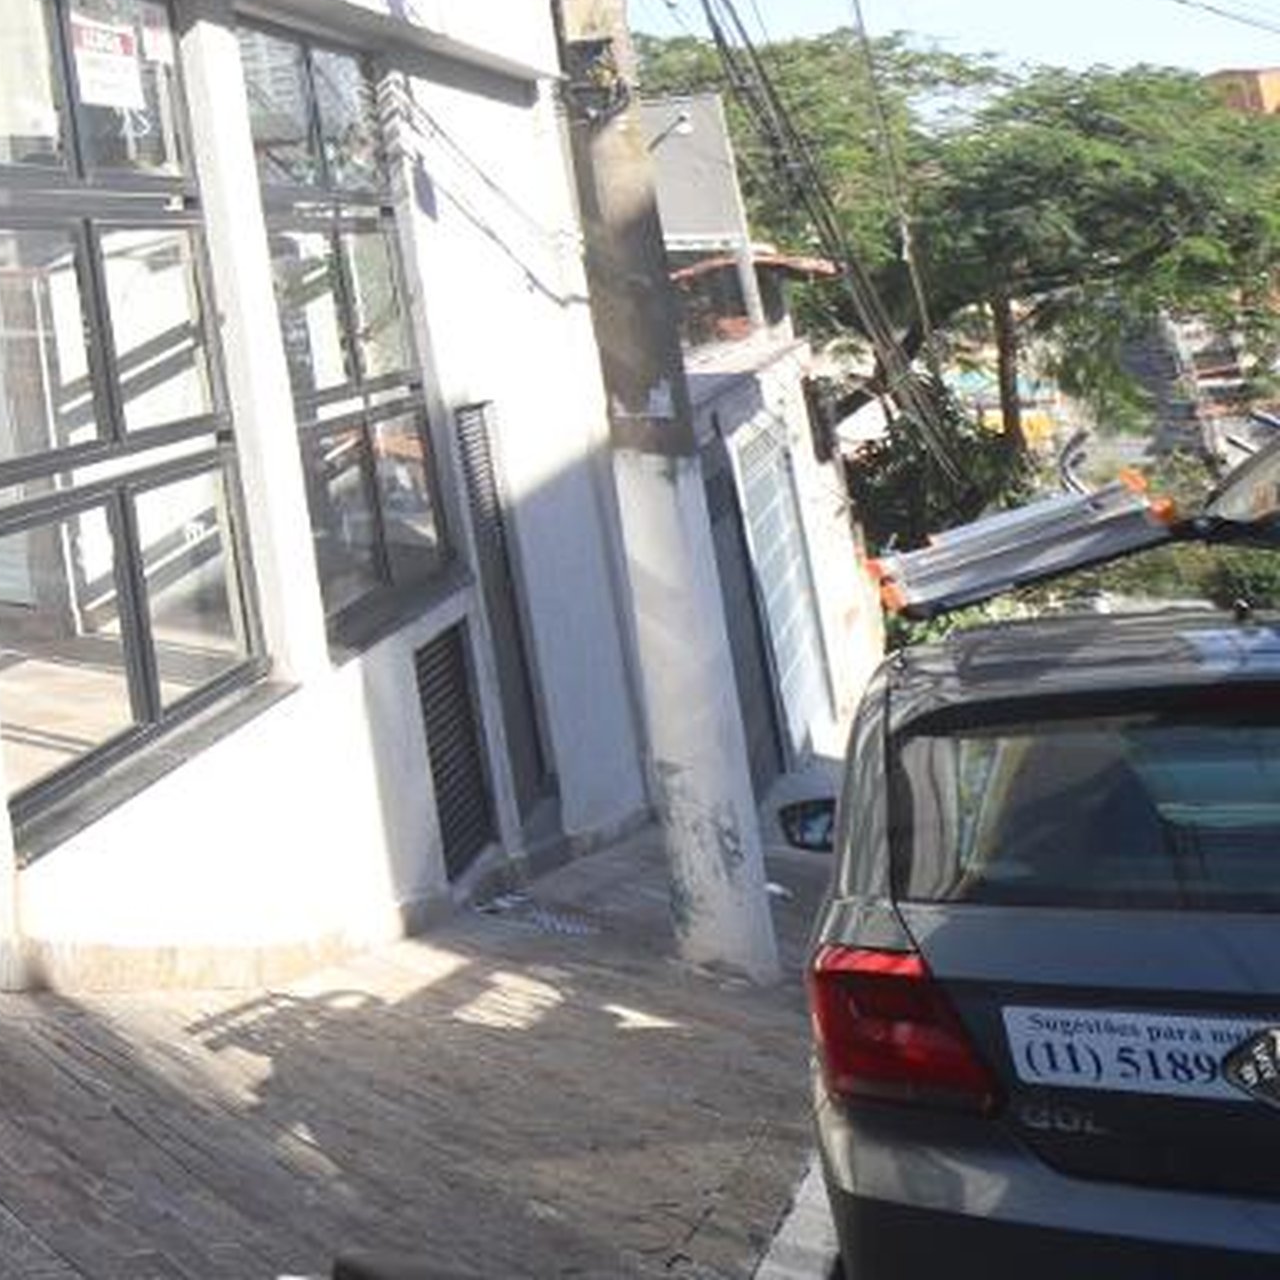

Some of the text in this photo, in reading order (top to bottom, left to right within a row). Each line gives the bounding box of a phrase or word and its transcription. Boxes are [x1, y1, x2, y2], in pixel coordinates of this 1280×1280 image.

[1146, 1024, 1203, 1042] para
[1025, 1040, 1103, 1081] (11)
[1116, 1045, 1219, 1084] 5189
